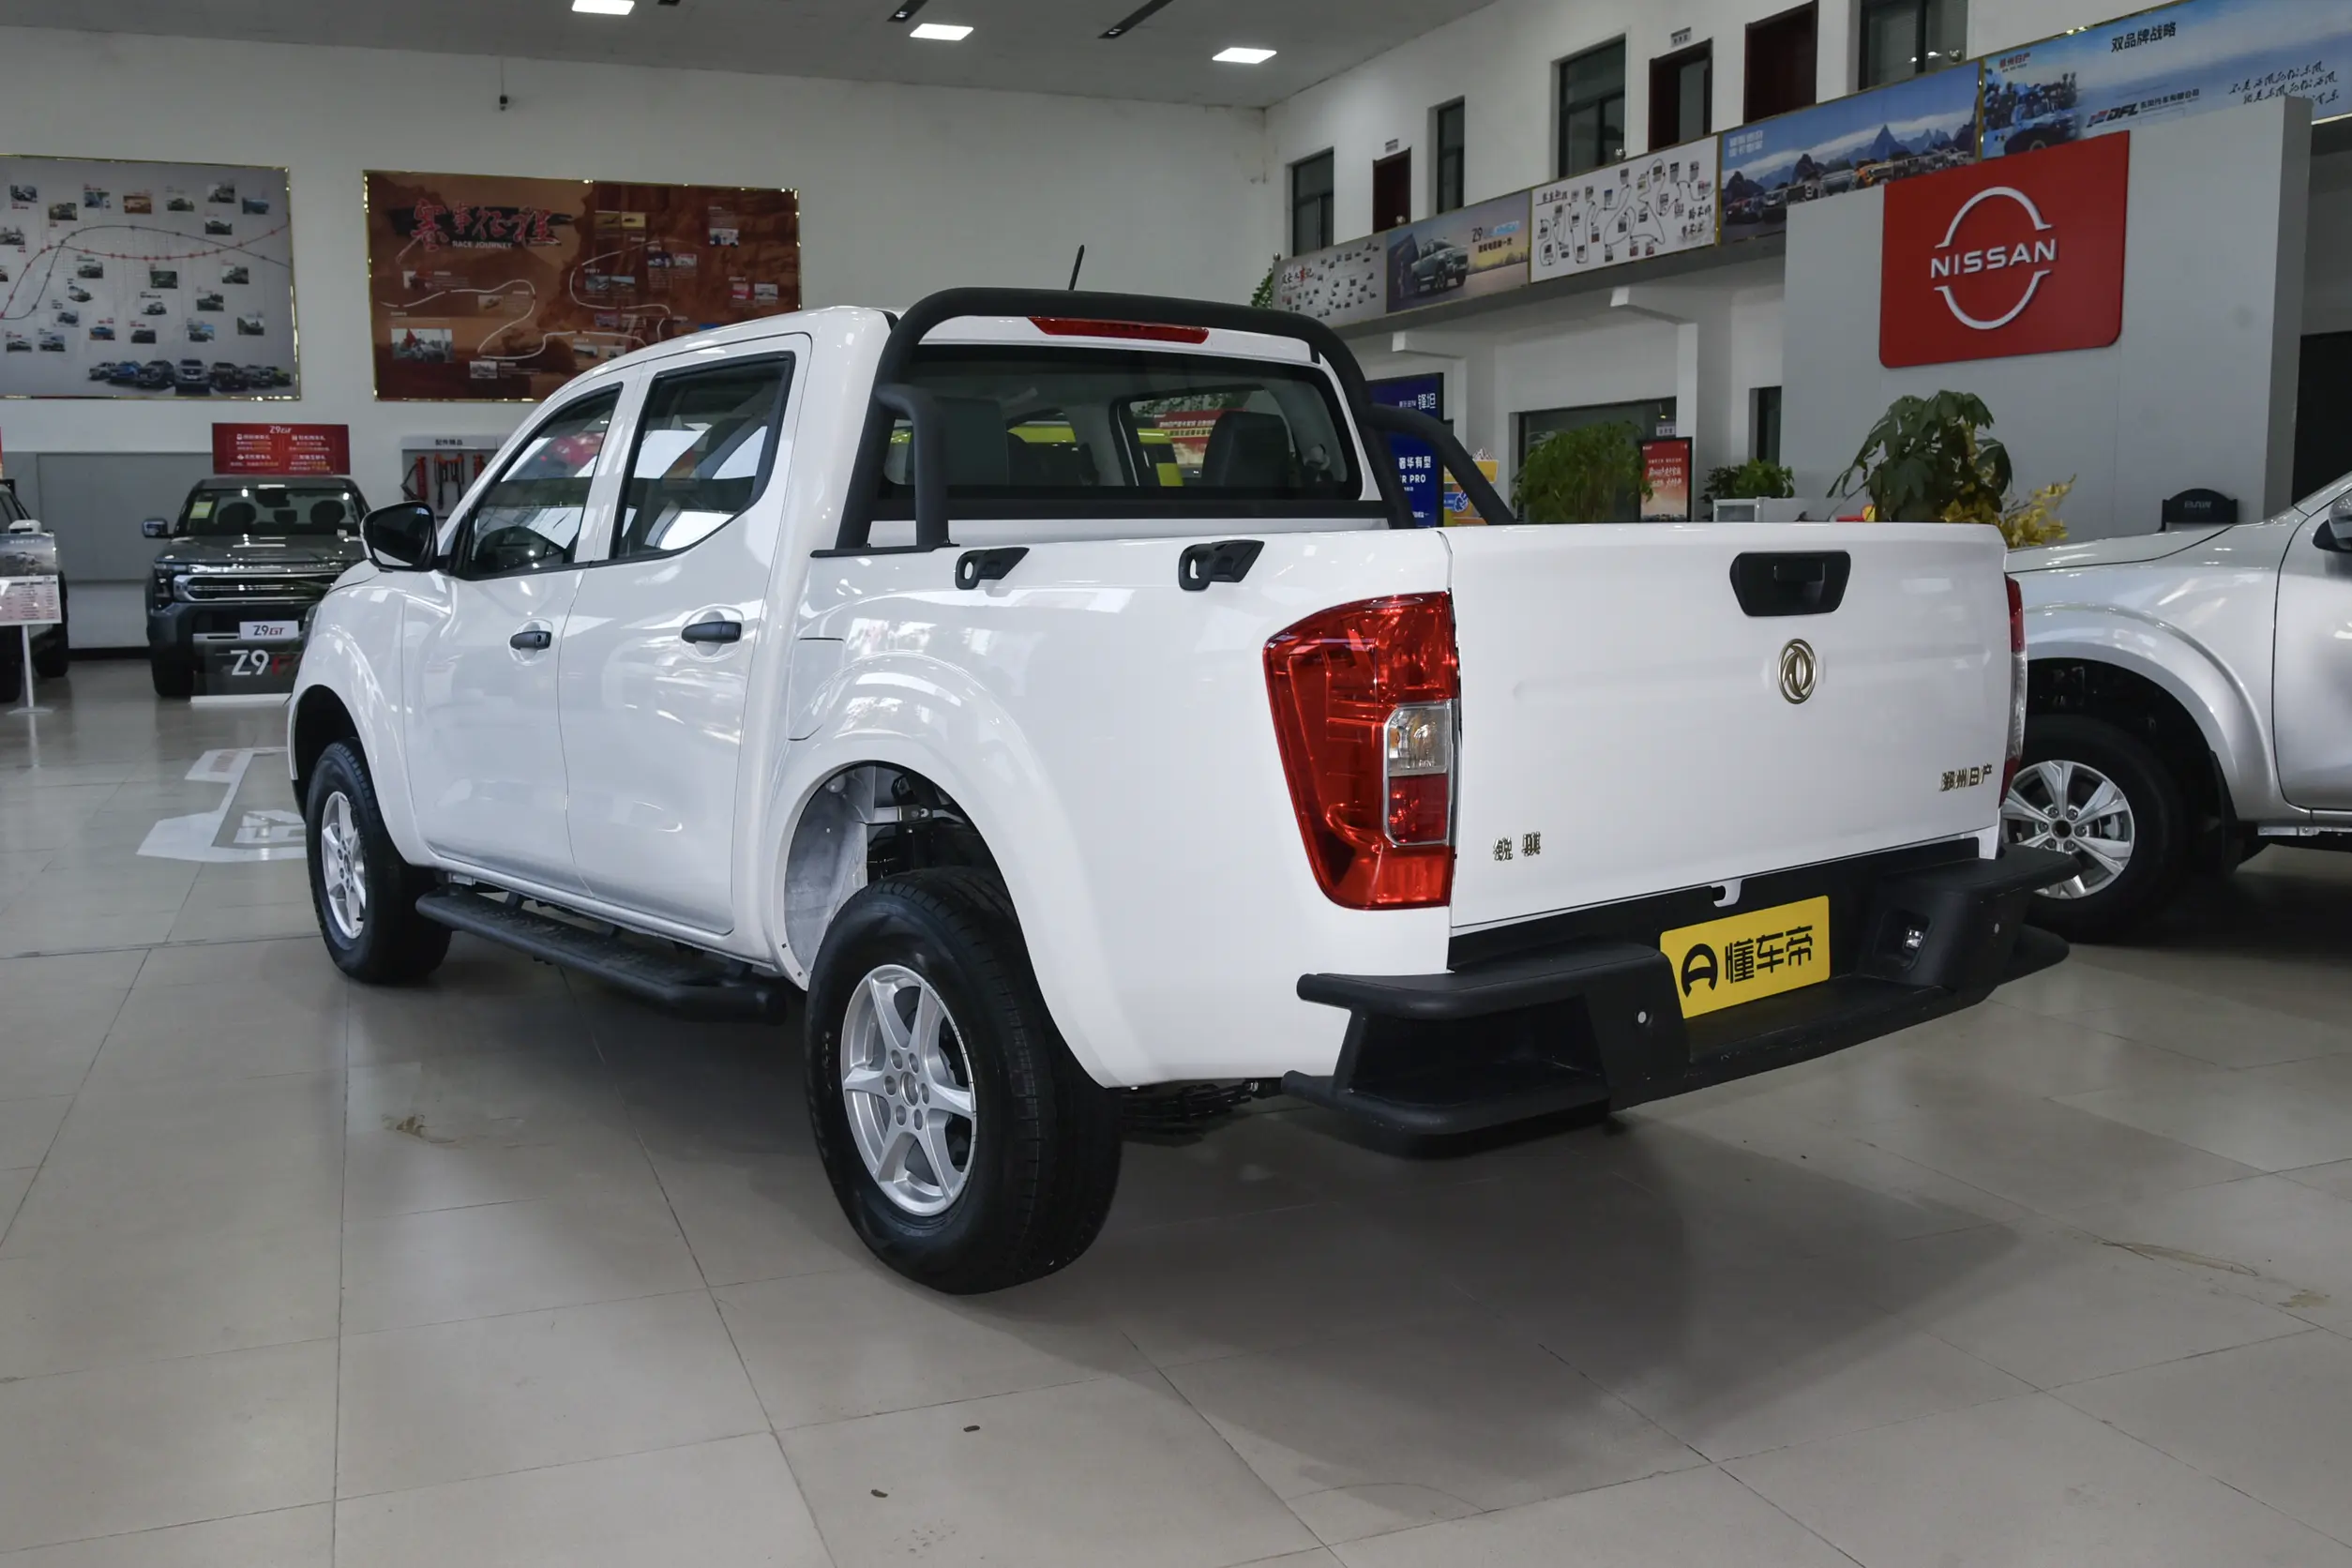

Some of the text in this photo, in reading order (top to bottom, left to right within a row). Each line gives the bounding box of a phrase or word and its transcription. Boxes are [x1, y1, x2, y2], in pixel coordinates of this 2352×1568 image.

[2111, 21, 2177, 53] 双品牌战略
[452, 240, 512, 249] RACE JOURNEY
[1931, 238, 2056, 279] NISSAN
[1410, 473, 1426, 484] PRO
[253, 625, 285, 637] Z9GT
[1939, 762, 1993, 792] 郑州日产
[1725, 925, 1814, 984] 懂车帝
